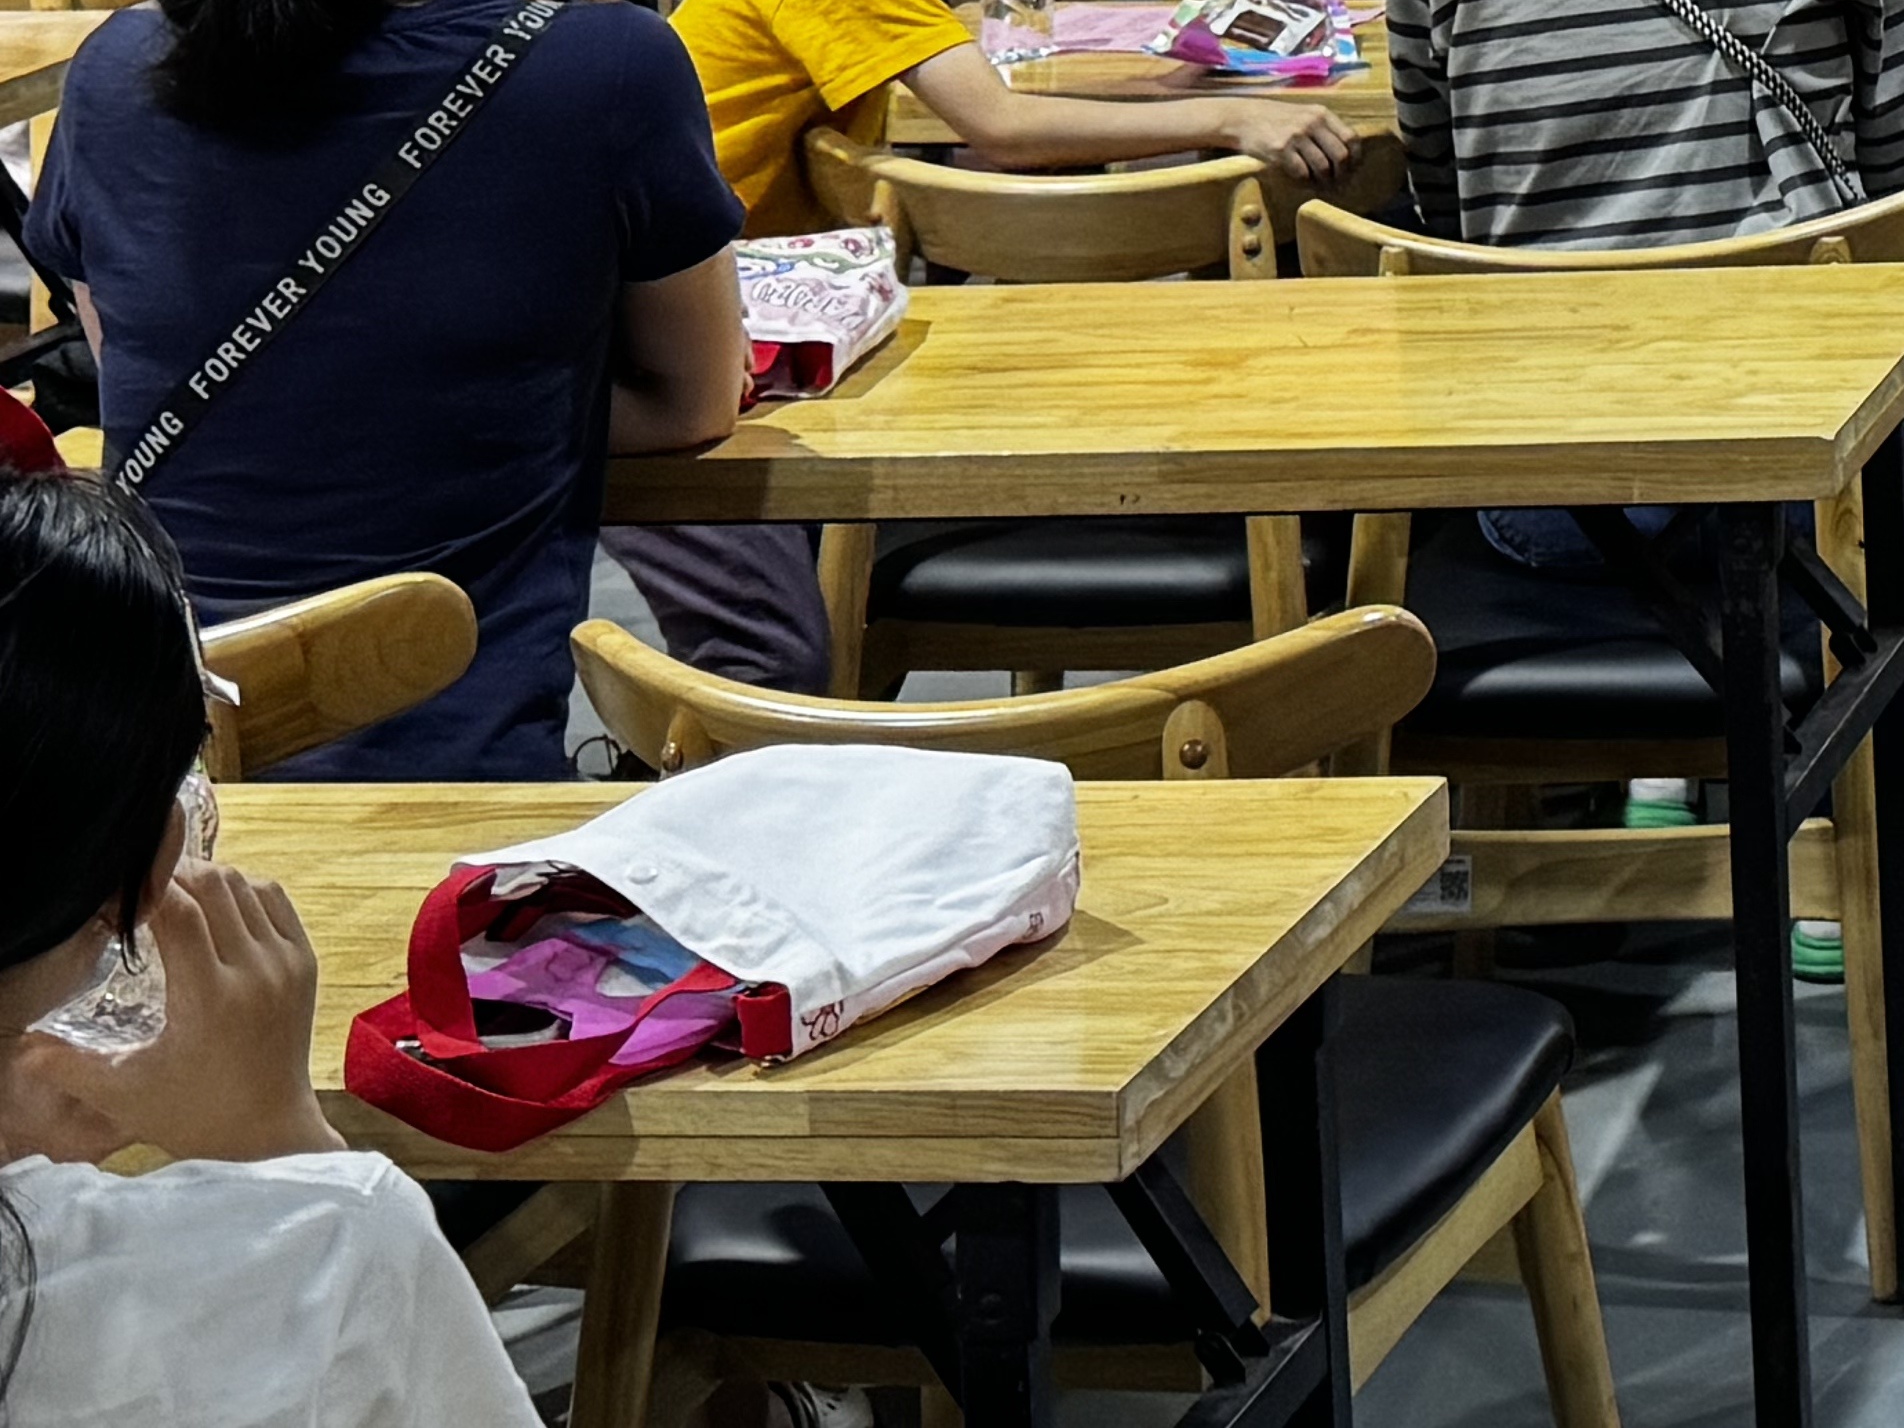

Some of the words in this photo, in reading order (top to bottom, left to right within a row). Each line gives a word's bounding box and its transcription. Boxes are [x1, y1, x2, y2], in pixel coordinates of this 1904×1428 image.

[115, 410, 184, 496] YOUNG
[188, 275, 307, 400] FOREVER
[299, 183, 391, 275] YOUNG
[398, 43, 516, 169] FOREVER
